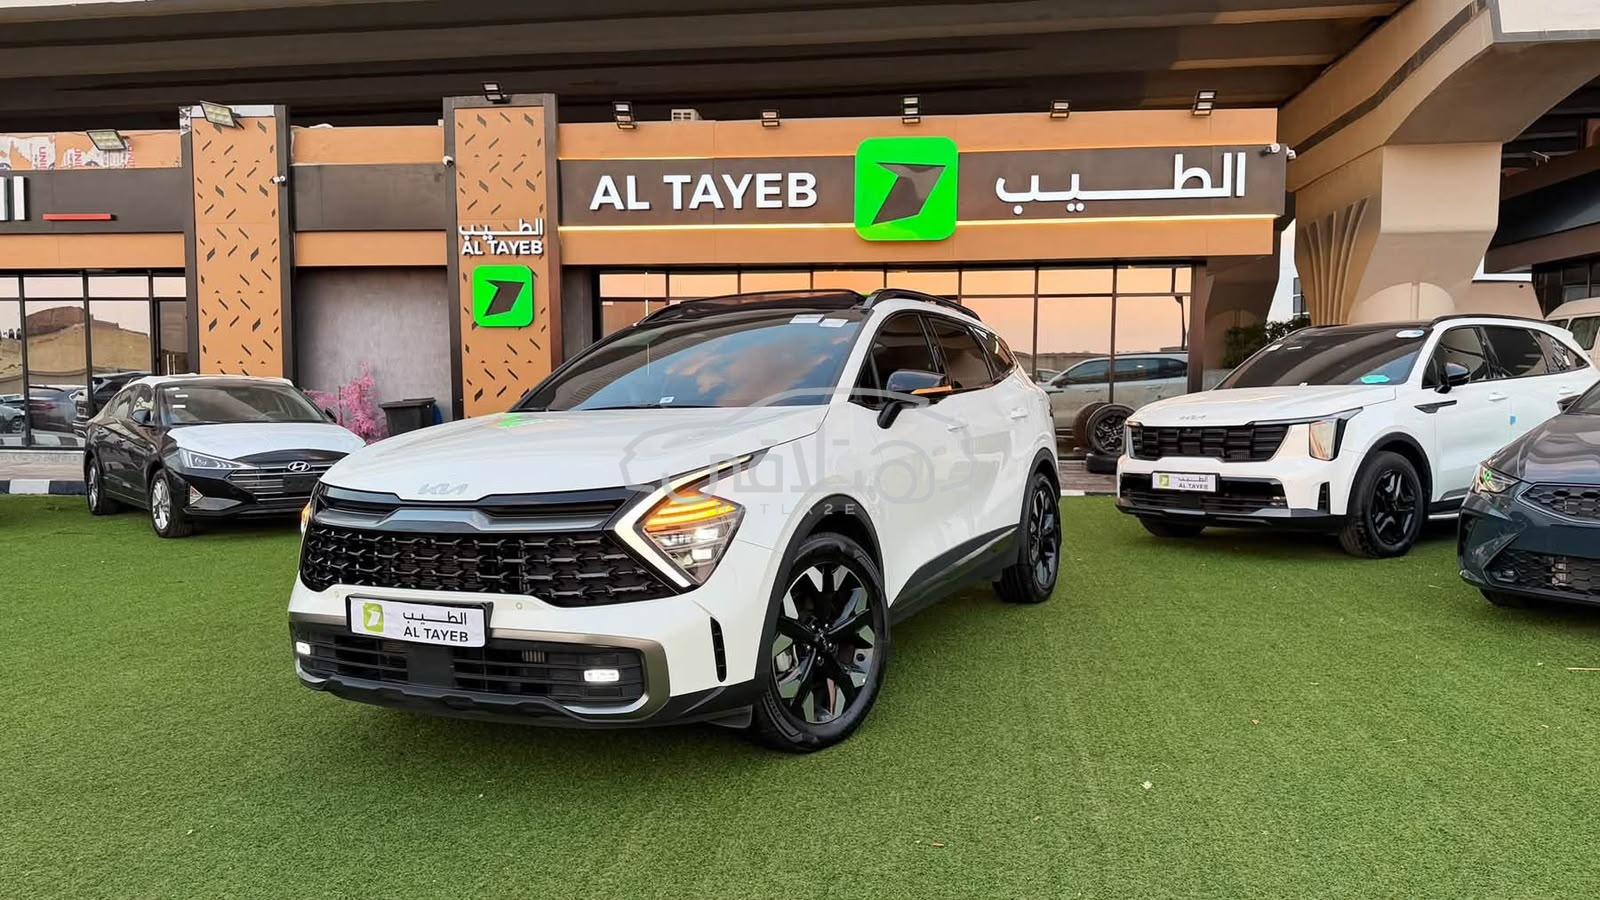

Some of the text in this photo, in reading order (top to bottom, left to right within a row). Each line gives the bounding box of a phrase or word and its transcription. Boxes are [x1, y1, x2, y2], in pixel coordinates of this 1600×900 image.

[589, 172, 818, 211] AL TAYEB
[996, 152, 1246, 215] الطيب
[459, 218, 543, 241] الطيب
[462, 240, 543, 255] AL TAYEB
[403, 611, 467, 625] الطيب
[404, 626, 468, 642] AL TAYEB
